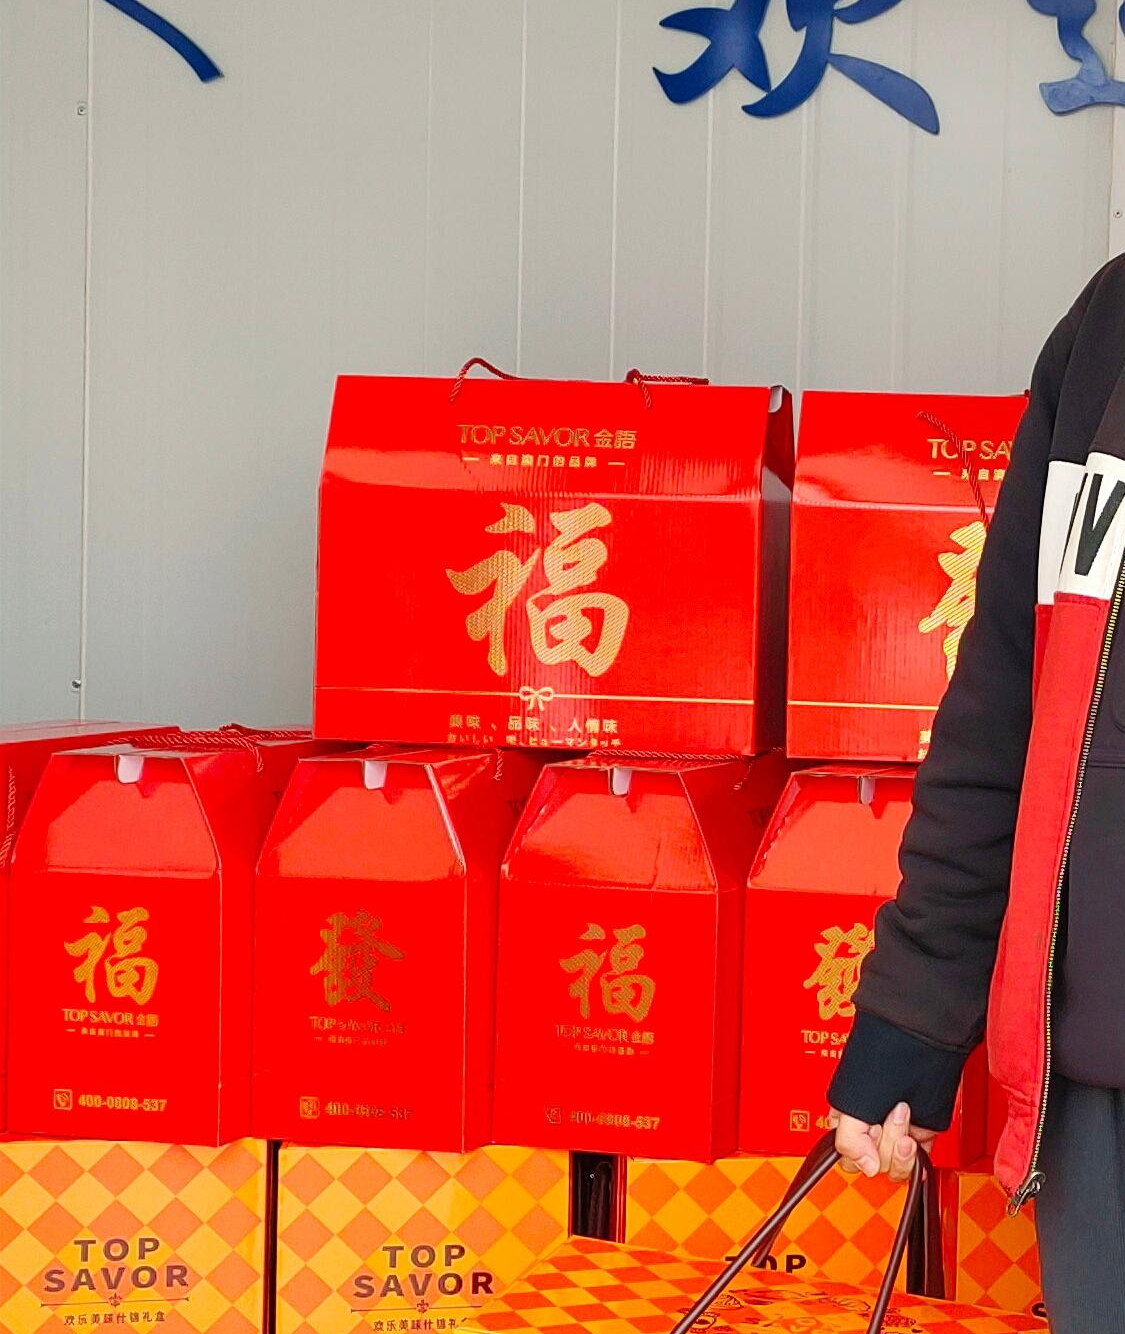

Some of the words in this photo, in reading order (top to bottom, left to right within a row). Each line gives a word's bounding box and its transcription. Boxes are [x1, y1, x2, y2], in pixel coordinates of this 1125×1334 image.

[456, 424, 506, 445] TOP
[508, 426, 591, 448] SAVOR
[445, 502, 629, 677] 福
[63, 906, 159, 1006] 福
[559, 922, 656, 1023] 福
[62, 1008, 89, 1022] TOP
[89, 1010, 134, 1026] SAVOR
[801, 1030, 829, 1044] TOP
[74, 1237, 161, 1263] TOP
[382, 1244, 467, 1269] TOP
[43, 1264, 190, 1293] SAVOR
[352, 1271, 495, 1298] SAVOR
